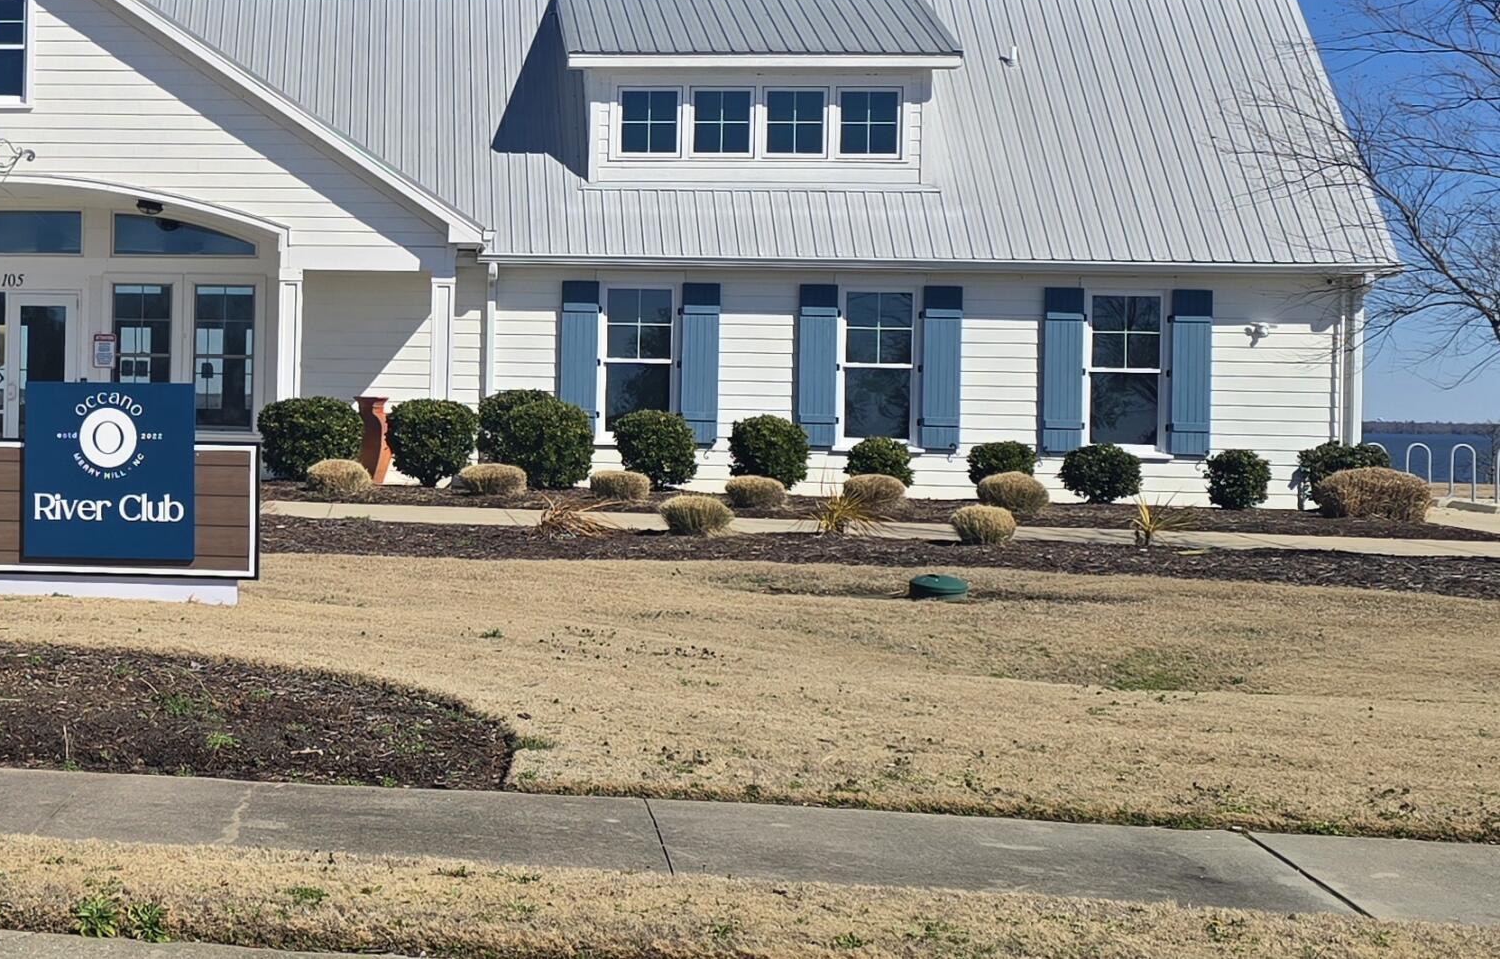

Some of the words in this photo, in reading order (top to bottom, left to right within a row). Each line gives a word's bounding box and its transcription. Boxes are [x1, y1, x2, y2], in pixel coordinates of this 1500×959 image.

[1, 273, 25, 288] 105
[75, 392, 143, 416] occano
[103, 470, 126, 480] HILL
[132, 453, 145, 466] NC
[33, 493, 112, 521] River
[118, 493, 185, 522] Club
